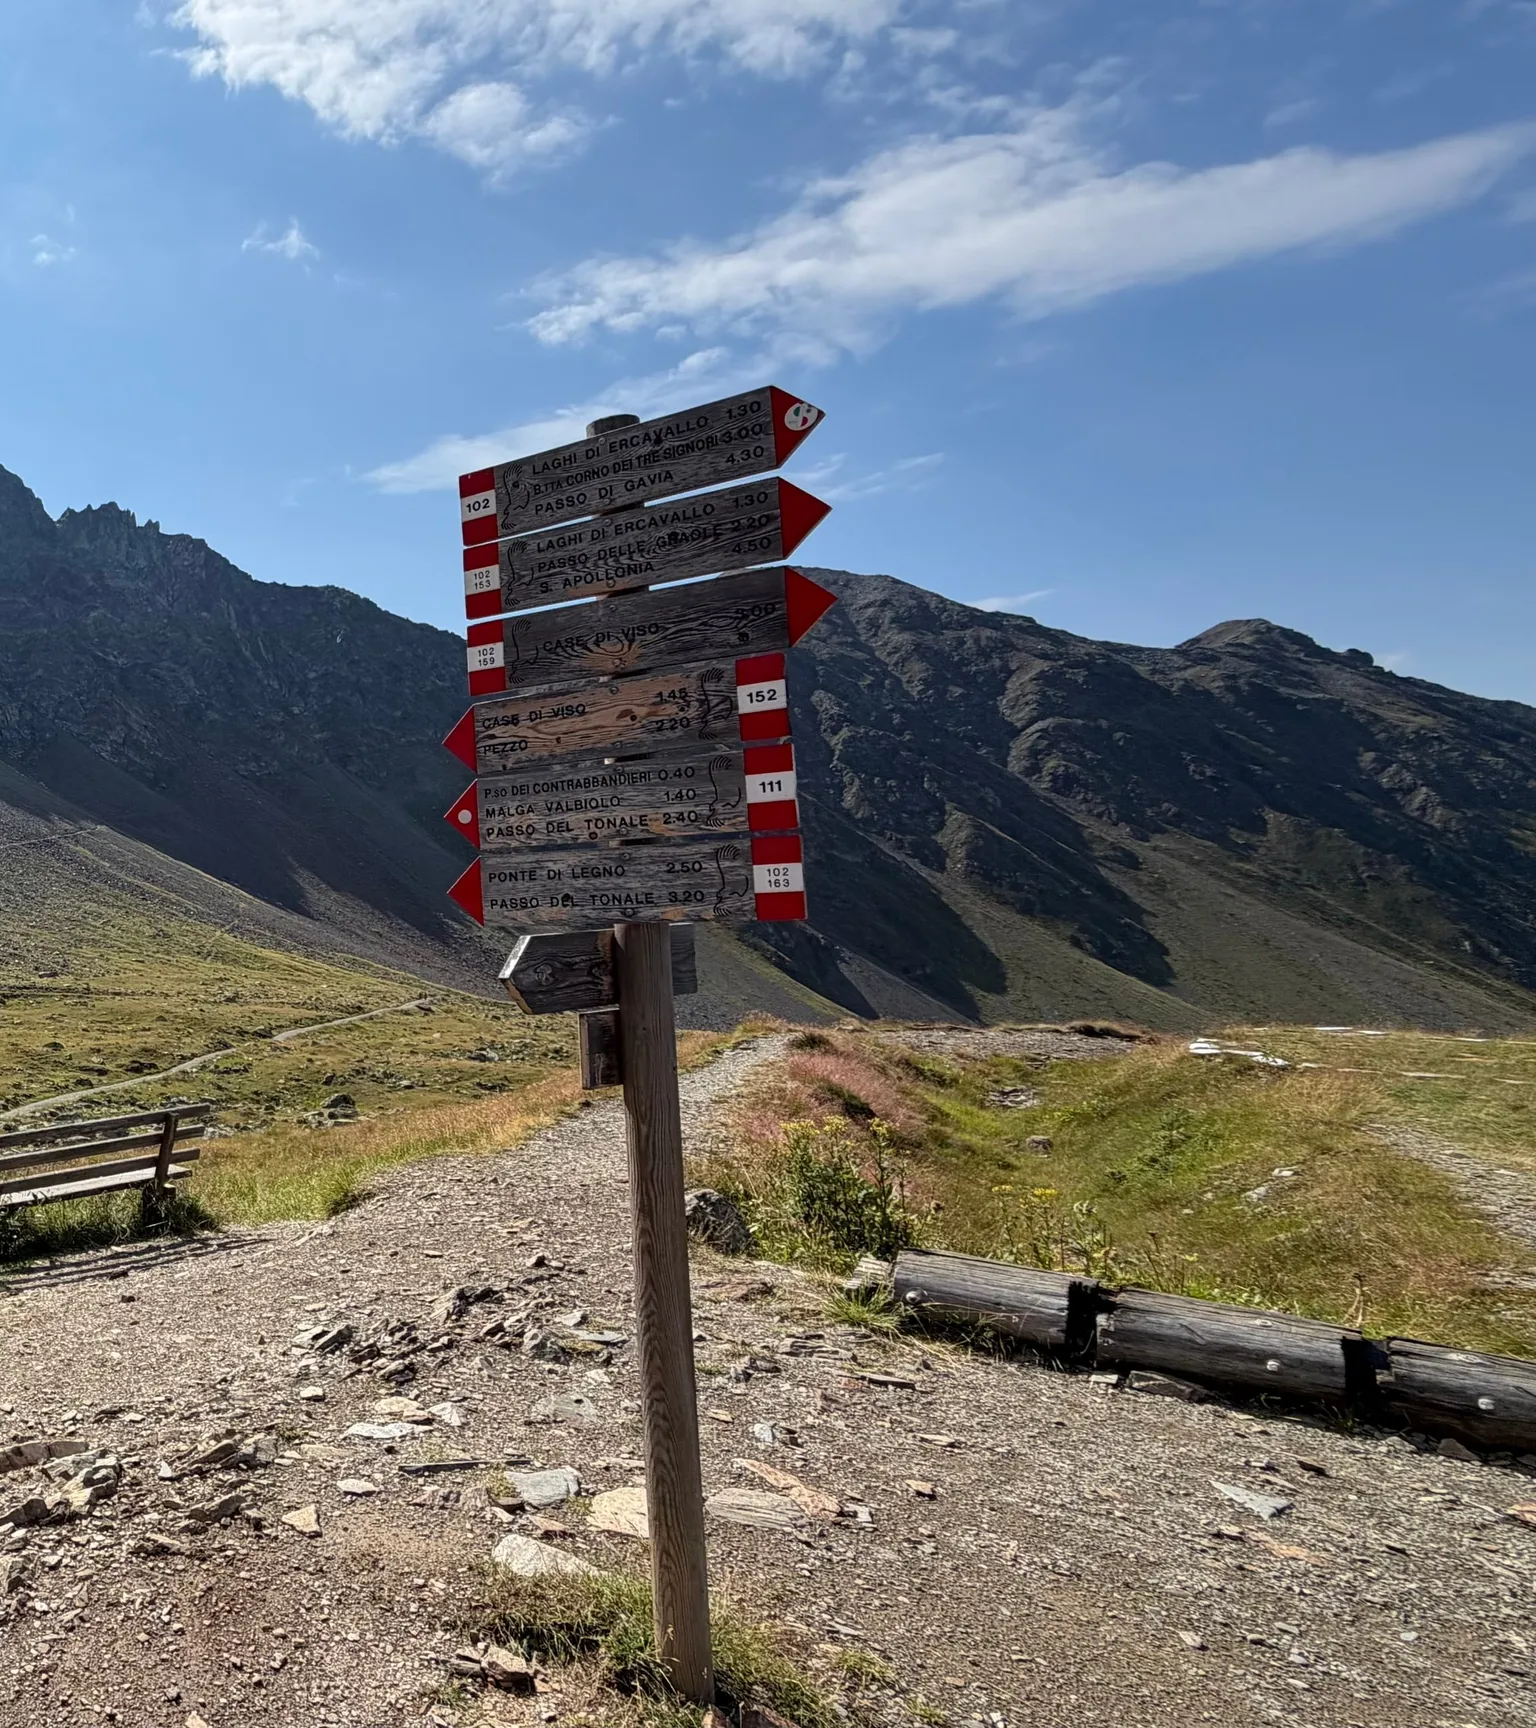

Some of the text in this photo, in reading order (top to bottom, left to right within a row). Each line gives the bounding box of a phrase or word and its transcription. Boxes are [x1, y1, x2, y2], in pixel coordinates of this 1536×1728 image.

[532, 400, 762, 475] LAGHI DI ERCAVALLO 1.30
[566, 465, 610, 487] CORNO
[613, 458, 633, 475] DEI
[636, 452, 661, 468] TRE
[664, 434, 719, 460] SIGNORI
[722, 423, 764, 445] 3.00
[535, 445, 764, 515] PASSO DI GAVIA 4.30
[466, 498, 490, 514] 102
[537, 491, 769, 554] LAGHI DI ERCAVALLO 1.30
[537, 514, 770, 573] PASSO DELLE GRAOLE 2.20
[473, 570, 490, 580] 102
[539, 536, 773, 595] S. APOLLONIA 4.50
[474, 580, 491, 590] 153
[542, 635, 586, 652] CASE
[595, 631, 613, 644] DI
[621, 622, 660, 641] VISO
[477, 648, 495, 657] 102
[478, 657, 495, 667] 159
[482, 687, 688, 730] CASE DI VISO 1.45
[747, 688, 777, 704] 152
[482, 716, 689, 755] PEZZO 2.20
[511, 785, 530, 796] DEI
[533, 772, 651, 794] CONTRABBANDIERI
[658, 766, 695, 781] 0.40
[758, 780, 782, 793] 111
[485, 788, 696, 818] MALGA VALBIOLO 1.40
[486, 810, 698, 838] PASSO DEL TONALE 2.40
[488, 861, 703, 883] PONTE DI LEGNO 2.50
[766, 867, 790, 877] 102
[768, 878, 790, 888] 163
[490, 897, 539, 910] PASSO
[589, 893, 655, 906] TONALE
[668, 890, 705, 902] 3.20
